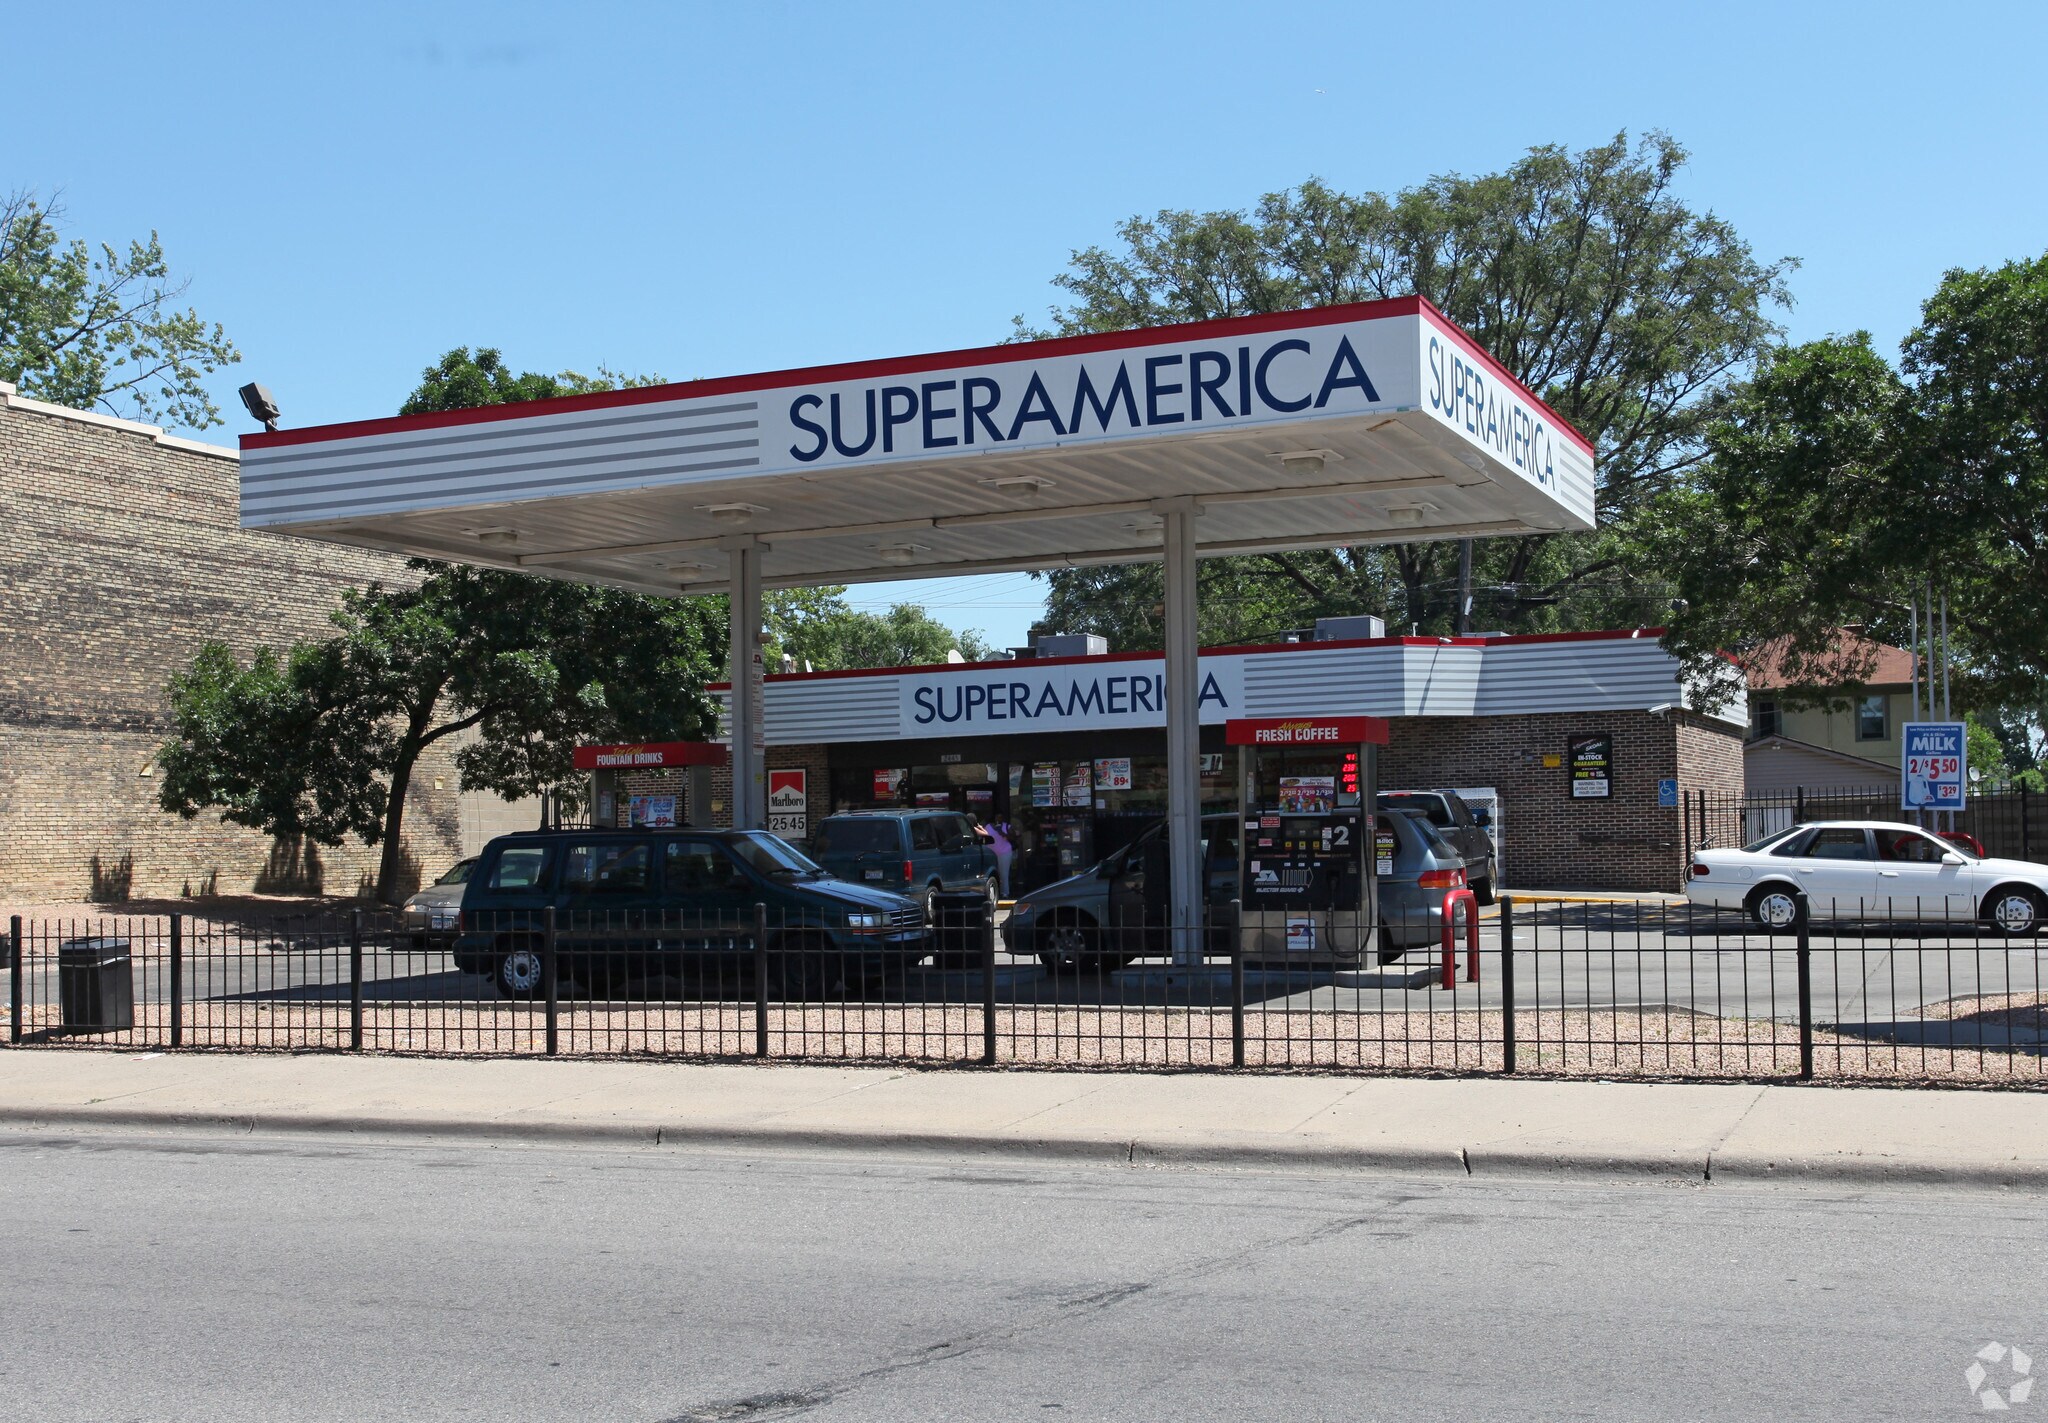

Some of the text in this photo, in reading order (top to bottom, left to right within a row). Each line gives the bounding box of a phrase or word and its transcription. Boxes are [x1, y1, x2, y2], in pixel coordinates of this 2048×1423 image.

[789, 334, 1380, 462] SUPERAMERICA
[1429, 336, 1556, 491] SUPERAMERICA
[914, 671, 1228, 724] SUPERAMERIA
[1278, 722, 1312, 730] Always
[1256, 727, 1339, 742] FRESH COFFEE
[1911, 737, 1956, 751] MILK
[597, 752, 663, 766] FOUNTAIN DRINKS
[771, 793, 804, 807] Marlboro
[1334, 825, 1349, 846] 2
[668, 843, 678, 857] 4
